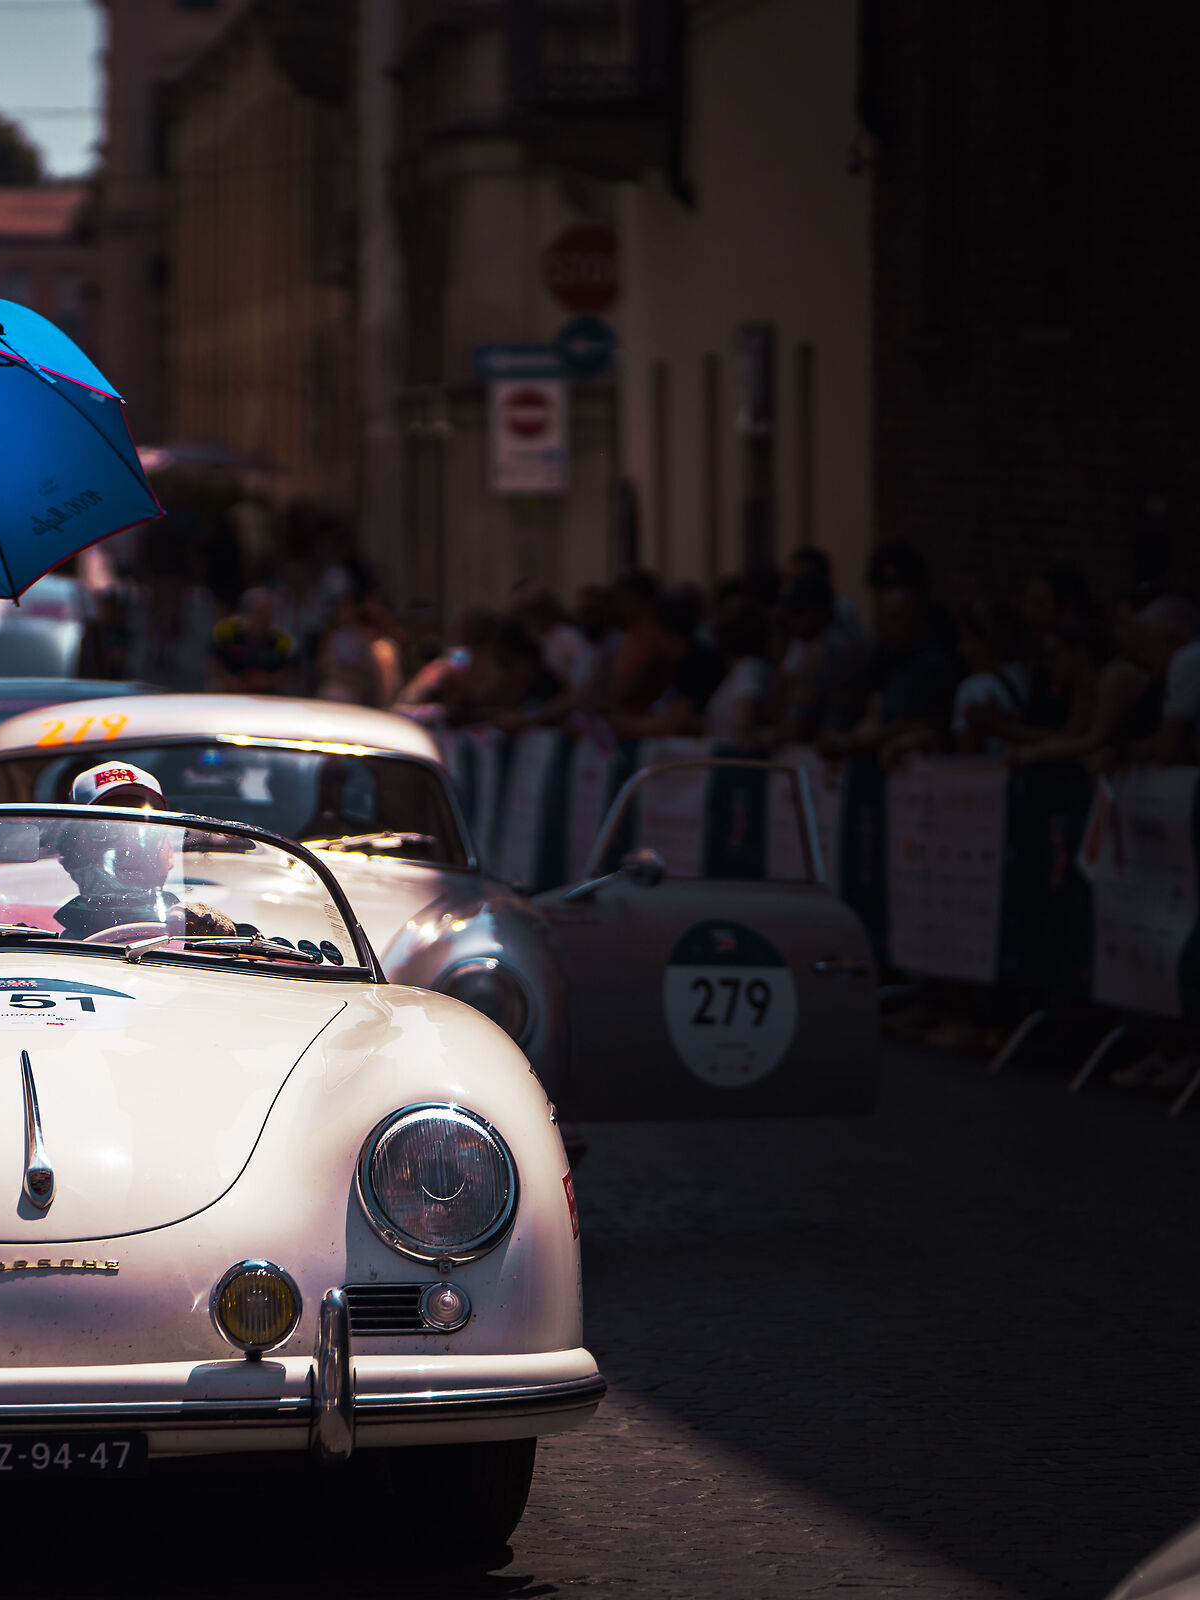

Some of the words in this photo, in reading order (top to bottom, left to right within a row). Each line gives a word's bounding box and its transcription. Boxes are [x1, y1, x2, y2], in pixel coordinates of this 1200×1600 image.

[34, 714, 128, 747] 279
[100, 769, 127, 778] 1000
[691, 978, 772, 1027] 279
